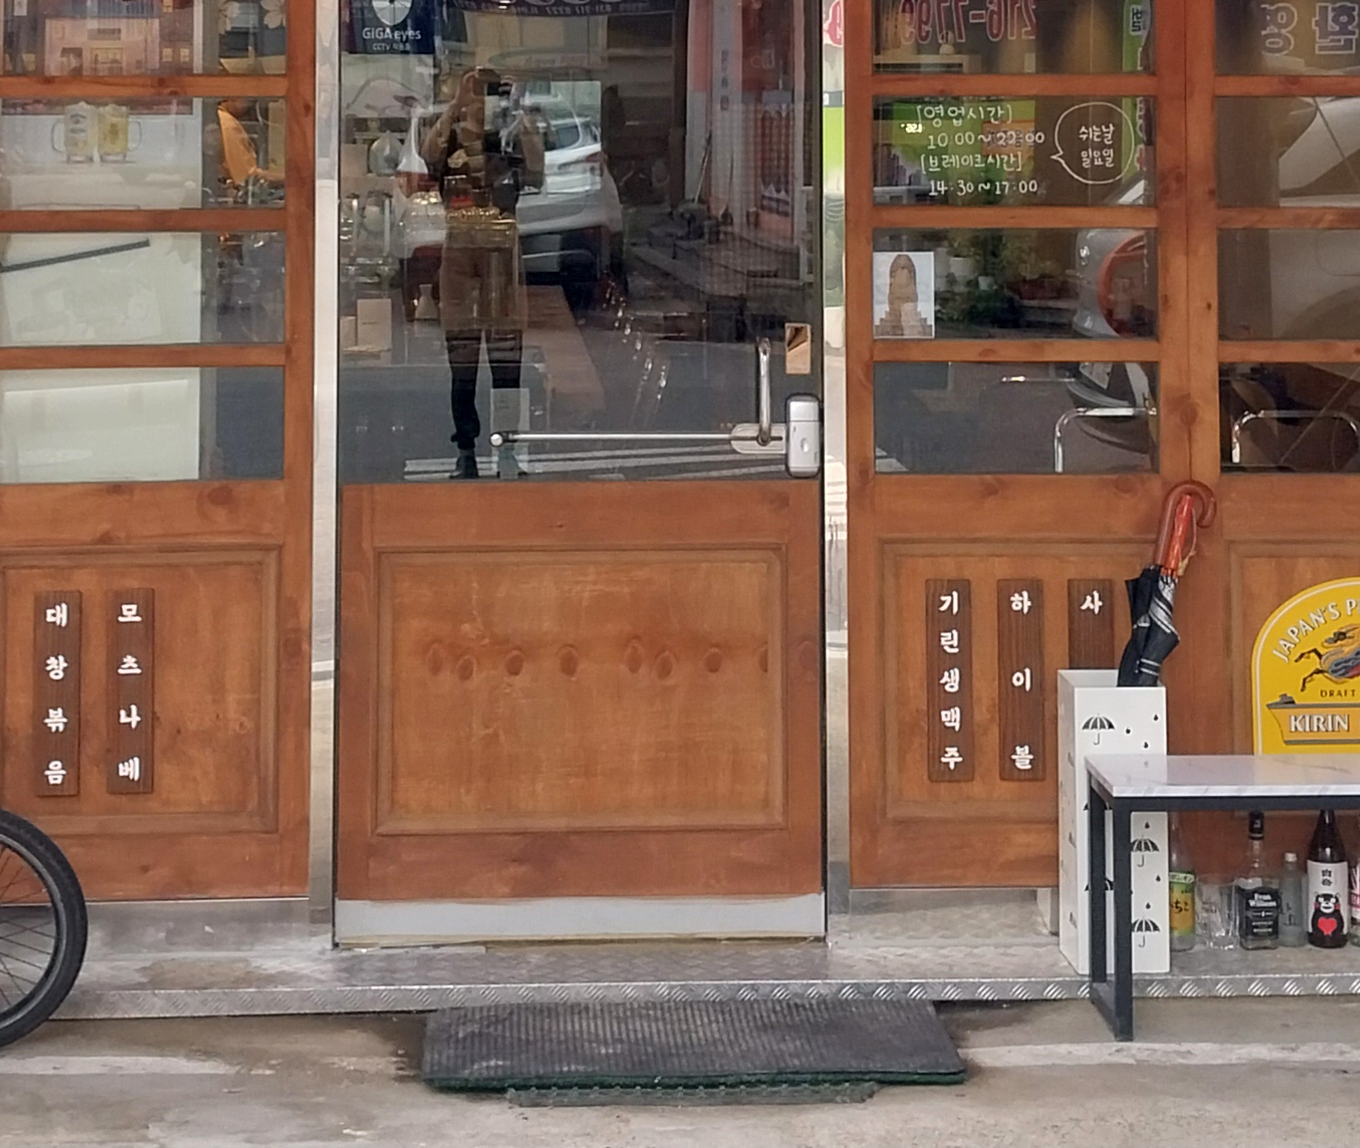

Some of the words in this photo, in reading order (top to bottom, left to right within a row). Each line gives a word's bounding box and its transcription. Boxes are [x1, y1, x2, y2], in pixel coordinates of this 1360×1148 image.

[1078, 123, 1115, 146] 쉬는날
[1080, 590, 1103, 615] 사
[1272, 602, 1341, 663] JAPAN'S
[43, 602, 68, 785] 대창볶음
[117, 604, 142, 781] 모츠나베
[938, 590, 963, 770] 기린생맥주
[1009, 590, 1034, 770] 하이볼
[1320, 688, 1356, 698] DRAFT
[1289, 713, 1350, 733] KIRIN
